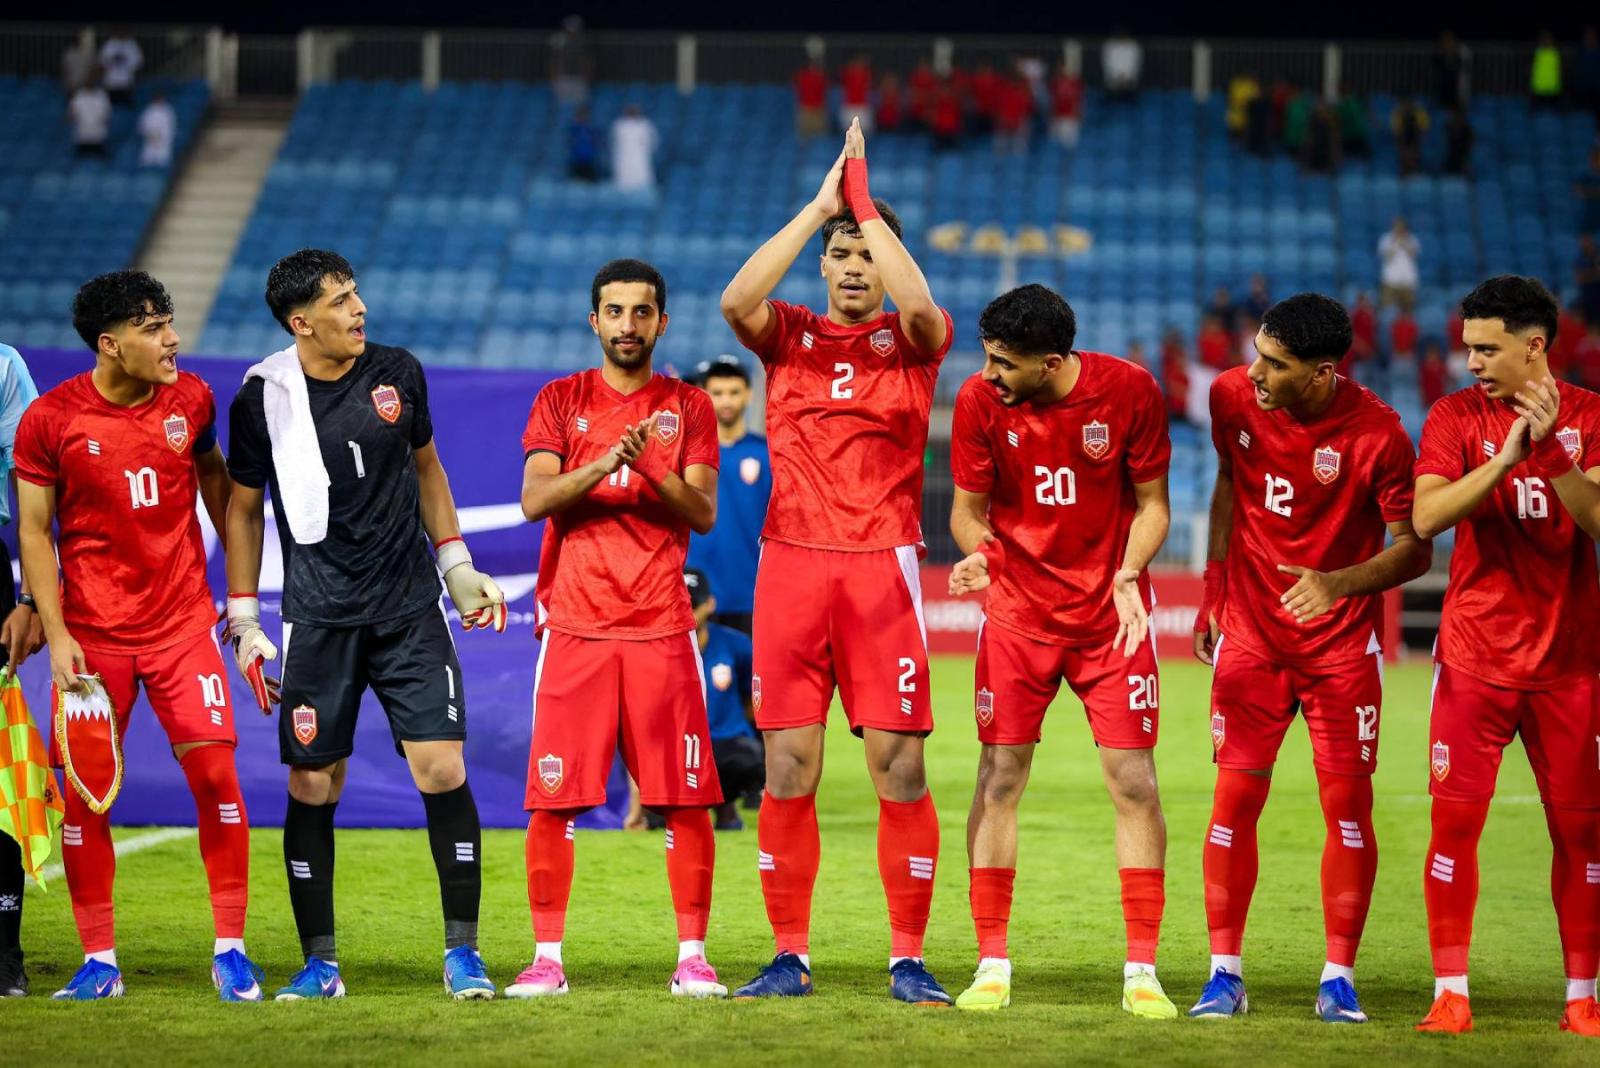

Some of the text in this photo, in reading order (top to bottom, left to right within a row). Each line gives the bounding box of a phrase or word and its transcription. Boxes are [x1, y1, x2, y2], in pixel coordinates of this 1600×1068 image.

[830, 362, 854, 400] 2
[347, 440, 365, 479] 1
[124, 466, 159, 510] 10
[1034, 465, 1077, 506] 20
[1264, 472, 1294, 518] 12
[1513, 476, 1548, 519] 16
[196, 673, 226, 708] 10
[445, 664, 456, 699] 1
[898, 657, 916, 693] 2
[1127, 674, 1158, 710] 20
[1355, 705, 1377, 741] 12
[684, 733, 700, 769] 11
